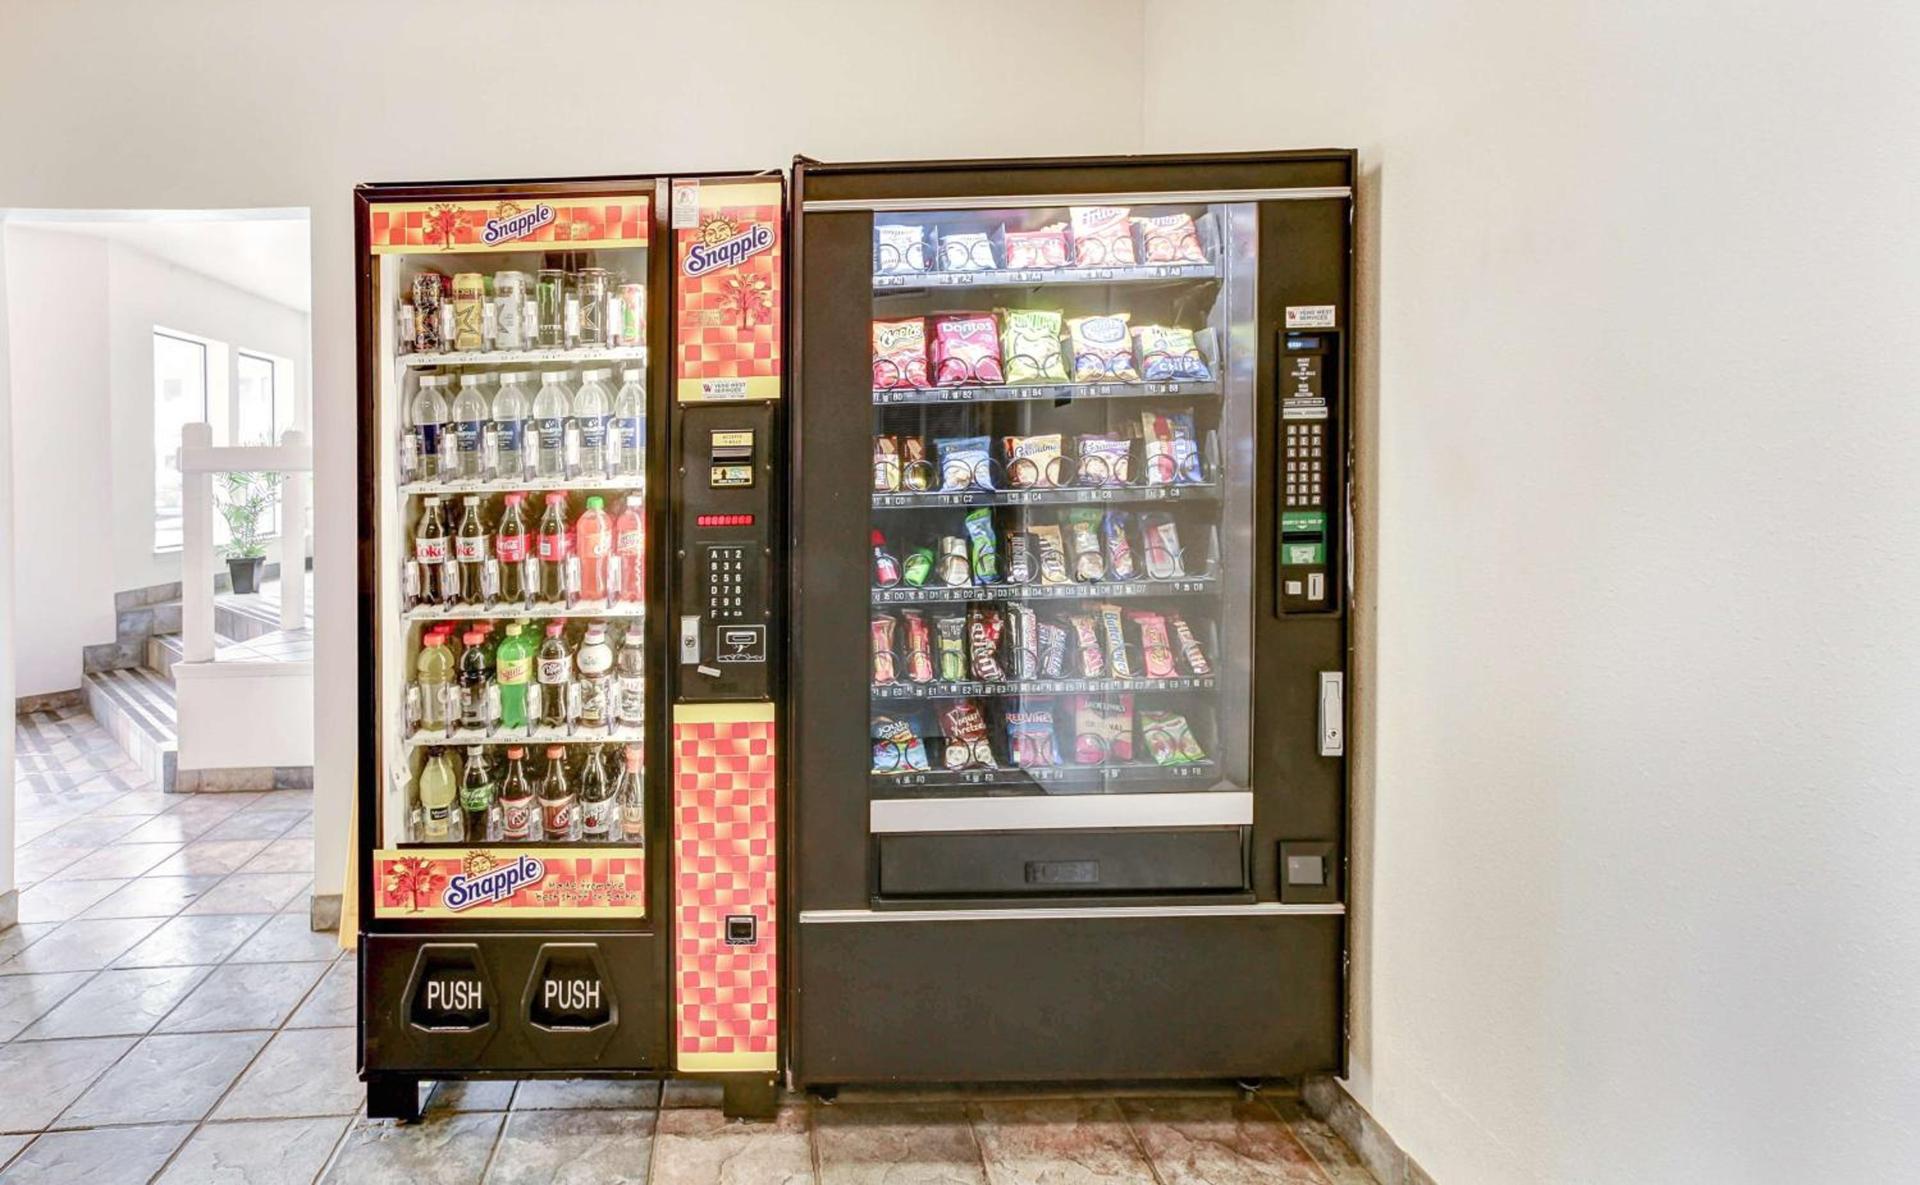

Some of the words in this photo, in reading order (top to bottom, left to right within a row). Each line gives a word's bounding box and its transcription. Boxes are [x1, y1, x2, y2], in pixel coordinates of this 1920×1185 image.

[485, 206, 551, 242] Snapple
[688, 226, 768, 272] Snapple
[943, 320, 993, 335] Doritos
[711, 550, 718, 558] A
[724, 550, 729, 558] 1
[735, 550, 741, 558] 2
[711, 562, 718, 570] B
[723, 562, 729, 570] 3
[735, 562, 741, 570] 4
[711, 574, 718, 582] C
[723, 574, 729, 582] 5
[735, 574, 741, 582] 6
[711, 586, 718, 594] D
[723, 586, 729, 594] 7
[735, 586, 741, 594] 8
[711, 598, 718, 606] E
[723, 598, 729, 606] 9
[735, 597, 741, 606] 0
[711, 610, 717, 619] F
[447, 857, 537, 906] Snapple
[428, 981, 482, 1009] PUSH
[545, 980, 600, 1008] PUSH
